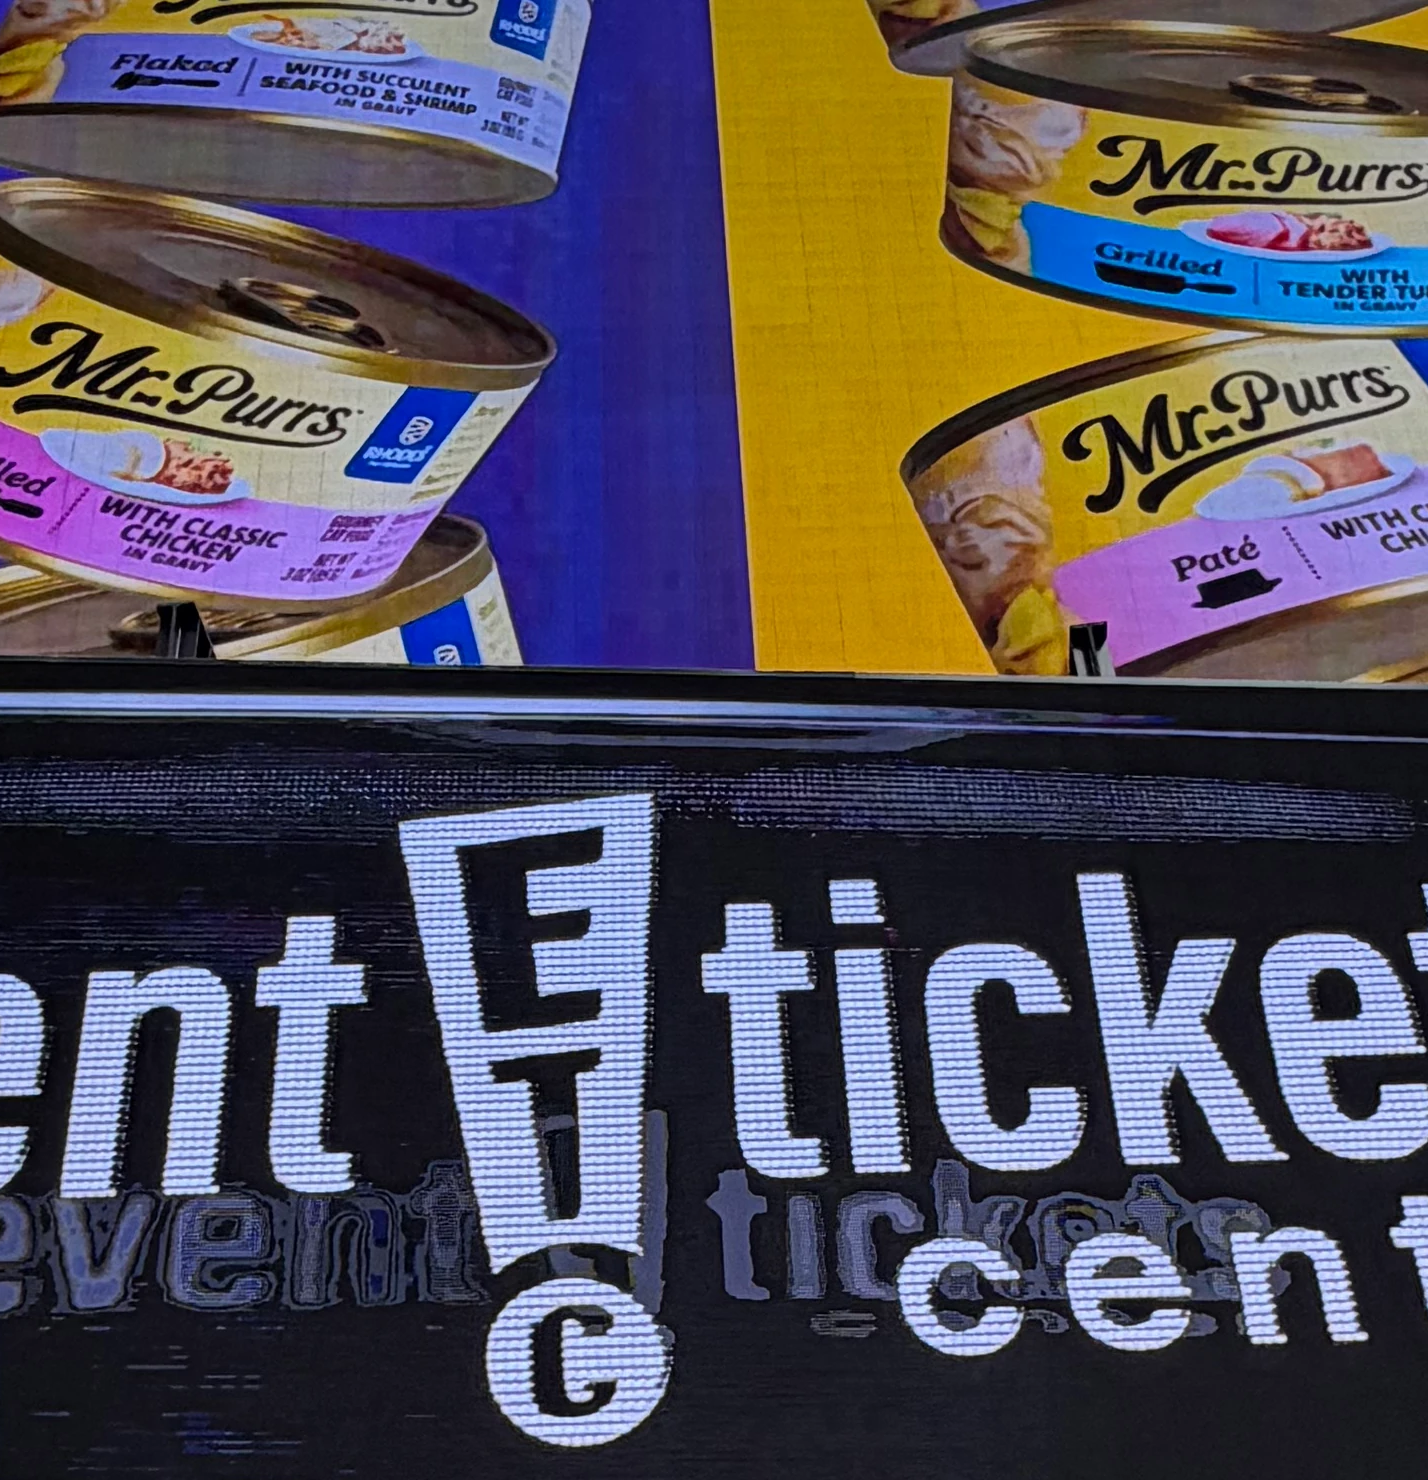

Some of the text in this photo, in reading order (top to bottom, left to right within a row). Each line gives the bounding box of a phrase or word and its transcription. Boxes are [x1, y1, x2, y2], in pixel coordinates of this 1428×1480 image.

[110, 52, 240, 76] Flaked
[284, 60, 471, 99] WITH SUCCULENT
[260, 76, 478, 116] SEAFOOD & SHRIMP
[1089, 134, 1255, 196] Mr.
[1094, 241, 1224, 279] Grilled
[1340, 267, 1410, 285] WITH
[1278, 278, 1388, 301] TENDER
[168, 364, 352, 444] Purrs
[1061, 363, 1414, 514] Mr. Purrs
[99, 495, 288, 551] WITH CLASSIC
[120, 522, 243, 563] CHICKEN
[1321, 506, 1410, 543] WITH
[123, 544, 215, 576] IN GRAVY
[1171, 534, 1262, 584] Paté
